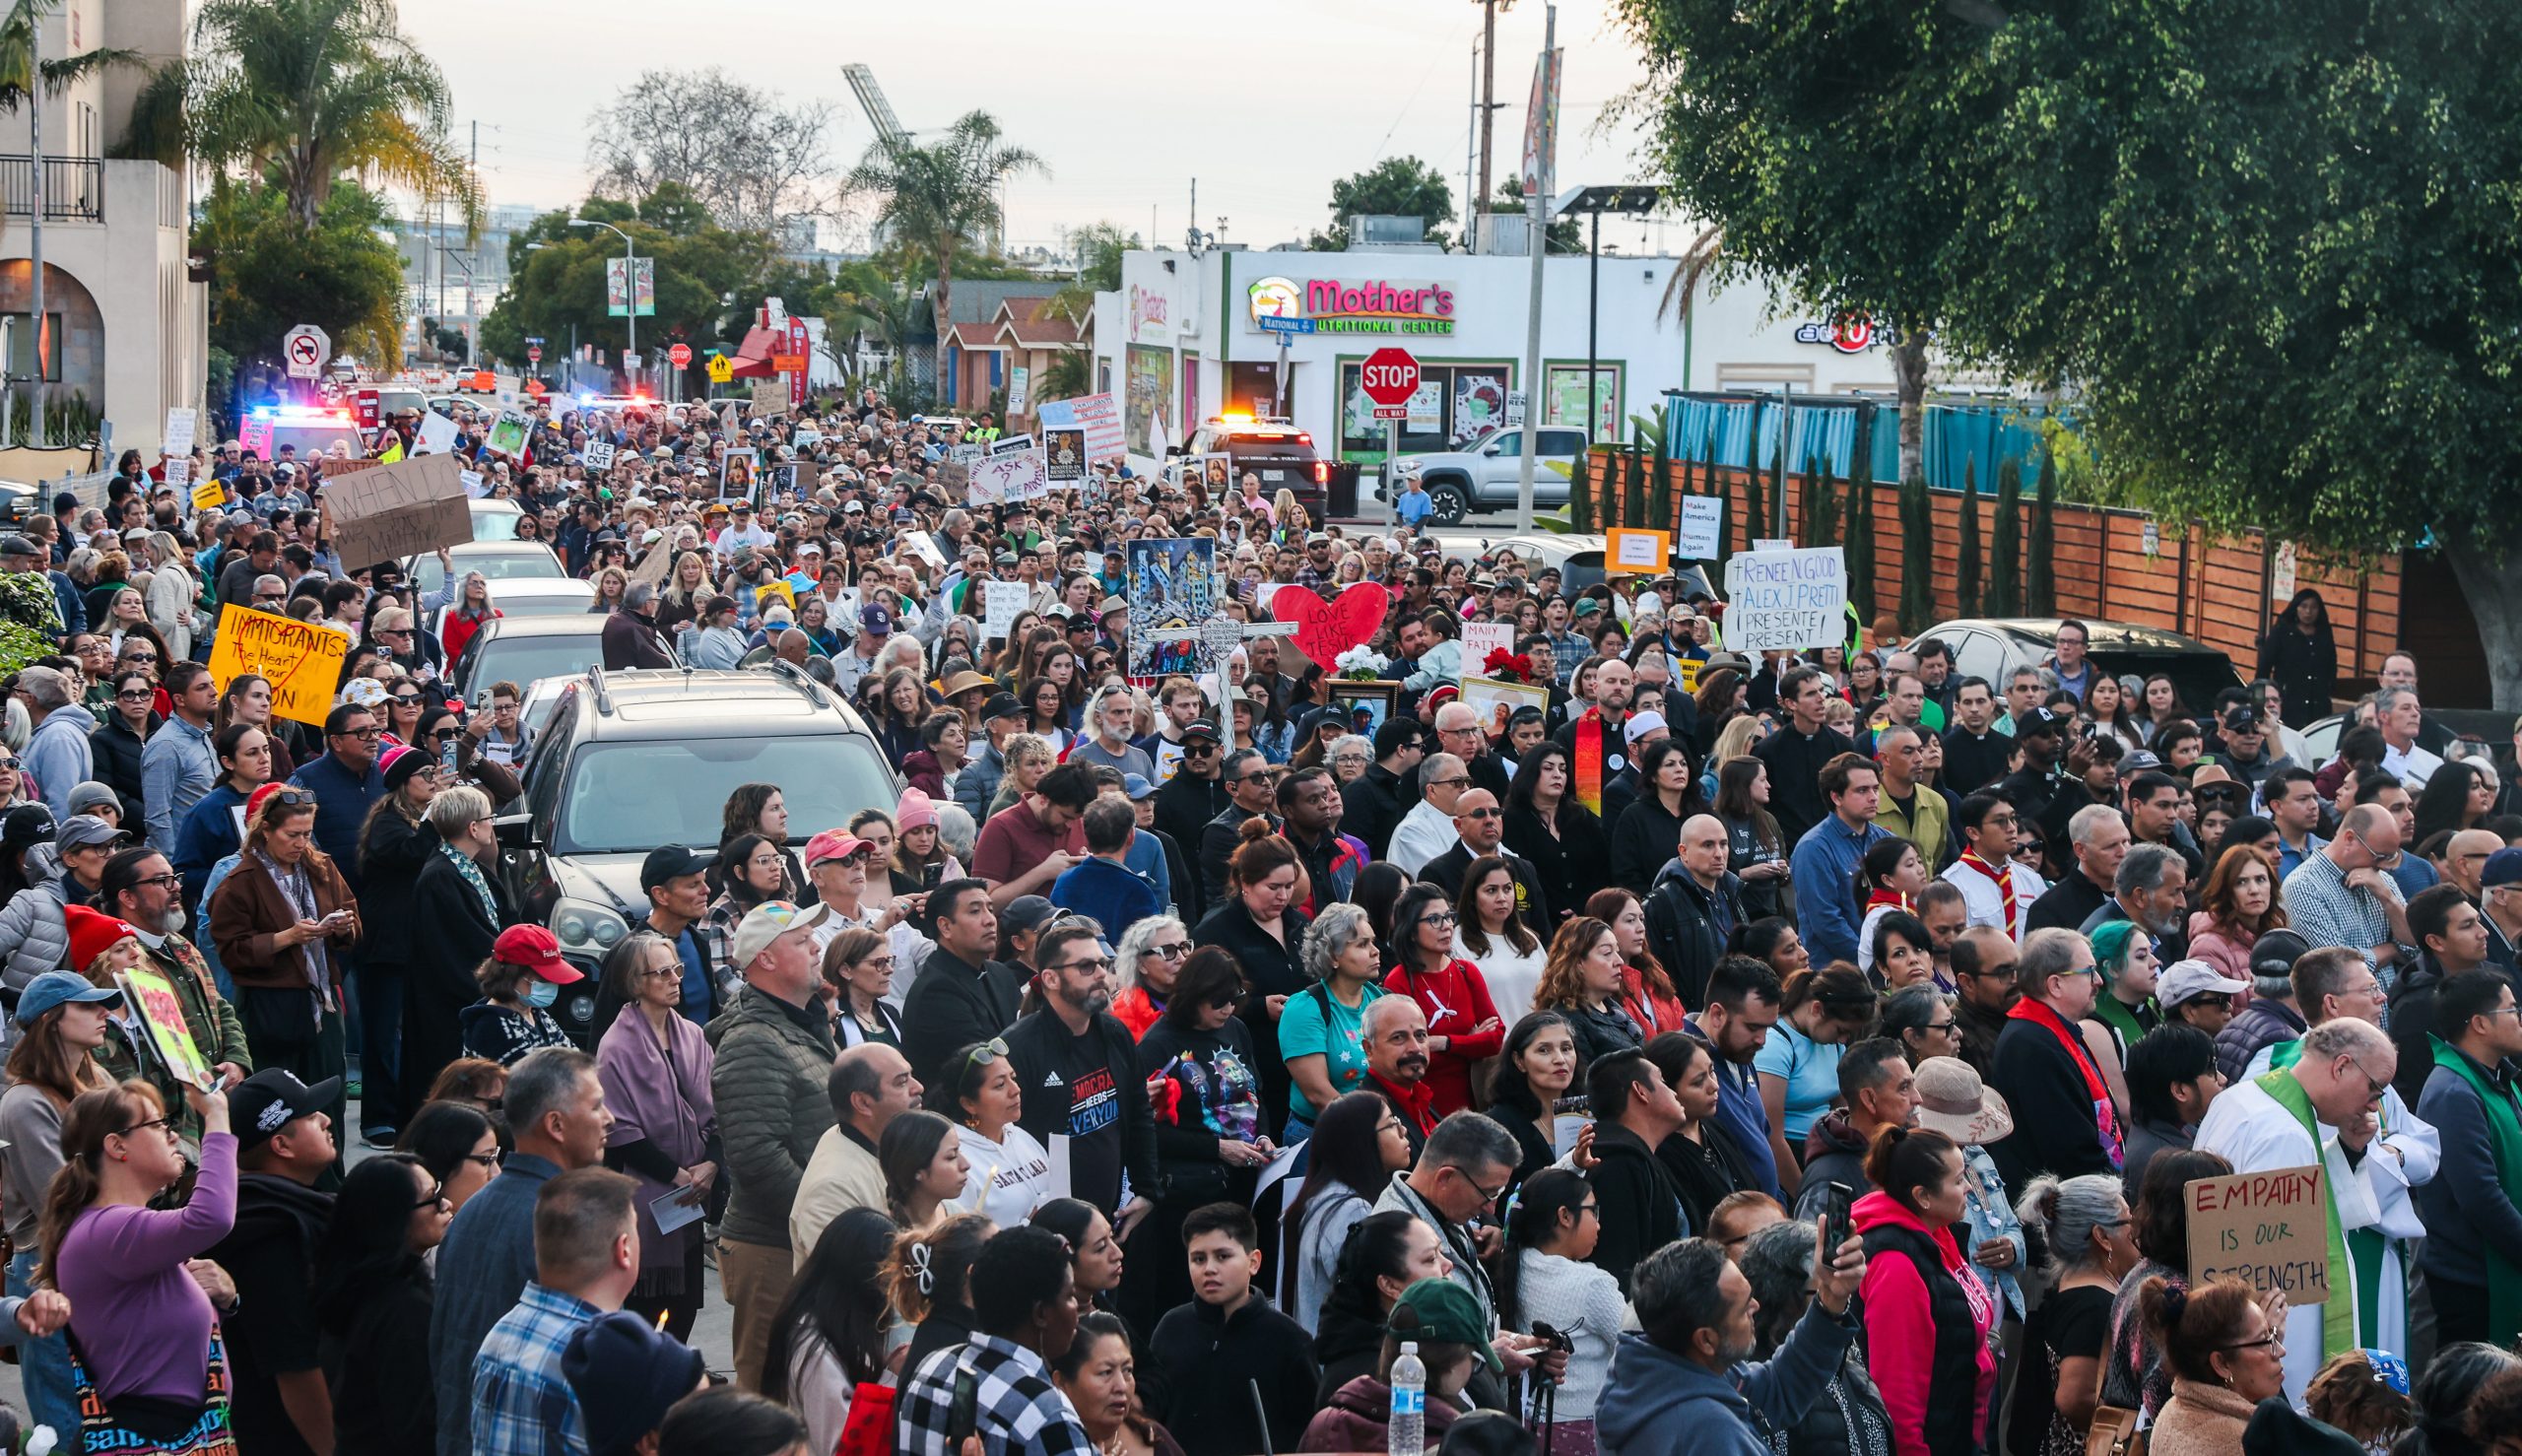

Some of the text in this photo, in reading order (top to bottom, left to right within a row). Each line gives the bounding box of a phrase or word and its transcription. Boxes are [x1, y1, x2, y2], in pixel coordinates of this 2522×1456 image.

[1307, 279, 1454, 316] Mother's
[1264, 317, 1299, 331] NATIONAL
[1318, 320, 1397, 333] UTRITIONAL
[1402, 321, 1452, 334] CENTER
[1364, 365, 1417, 388] STOP
[591, 443, 612, 455] ICE
[588, 456, 608, 466] OUT
[992, 460, 1023, 474] ASK
[1005, 485, 1023, 497] DUE
[1683, 533, 1710, 542] Human
[1682, 544, 1704, 553] Again
[1744, 558, 1790, 583] RENEE
[1804, 556, 1835, 580] GOOD
[1744, 586, 1782, 609] ALEX
[1308, 603, 1351, 625] LOVE
[231, 611, 347, 657] IMMIGRANTS:
[1315, 622, 1350, 639] LIKE
[1468, 626, 1497, 636] MANY
[1746, 629, 1814, 649] PRESENT
[232, 641, 299, 668] The Heart
[266, 668, 288, 679] our
[1086, 1091, 1107, 1109] NEEDS
[2197, 1169, 2319, 1213] EMPATHY
[2221, 1222, 2294, 1252] IS OUR
